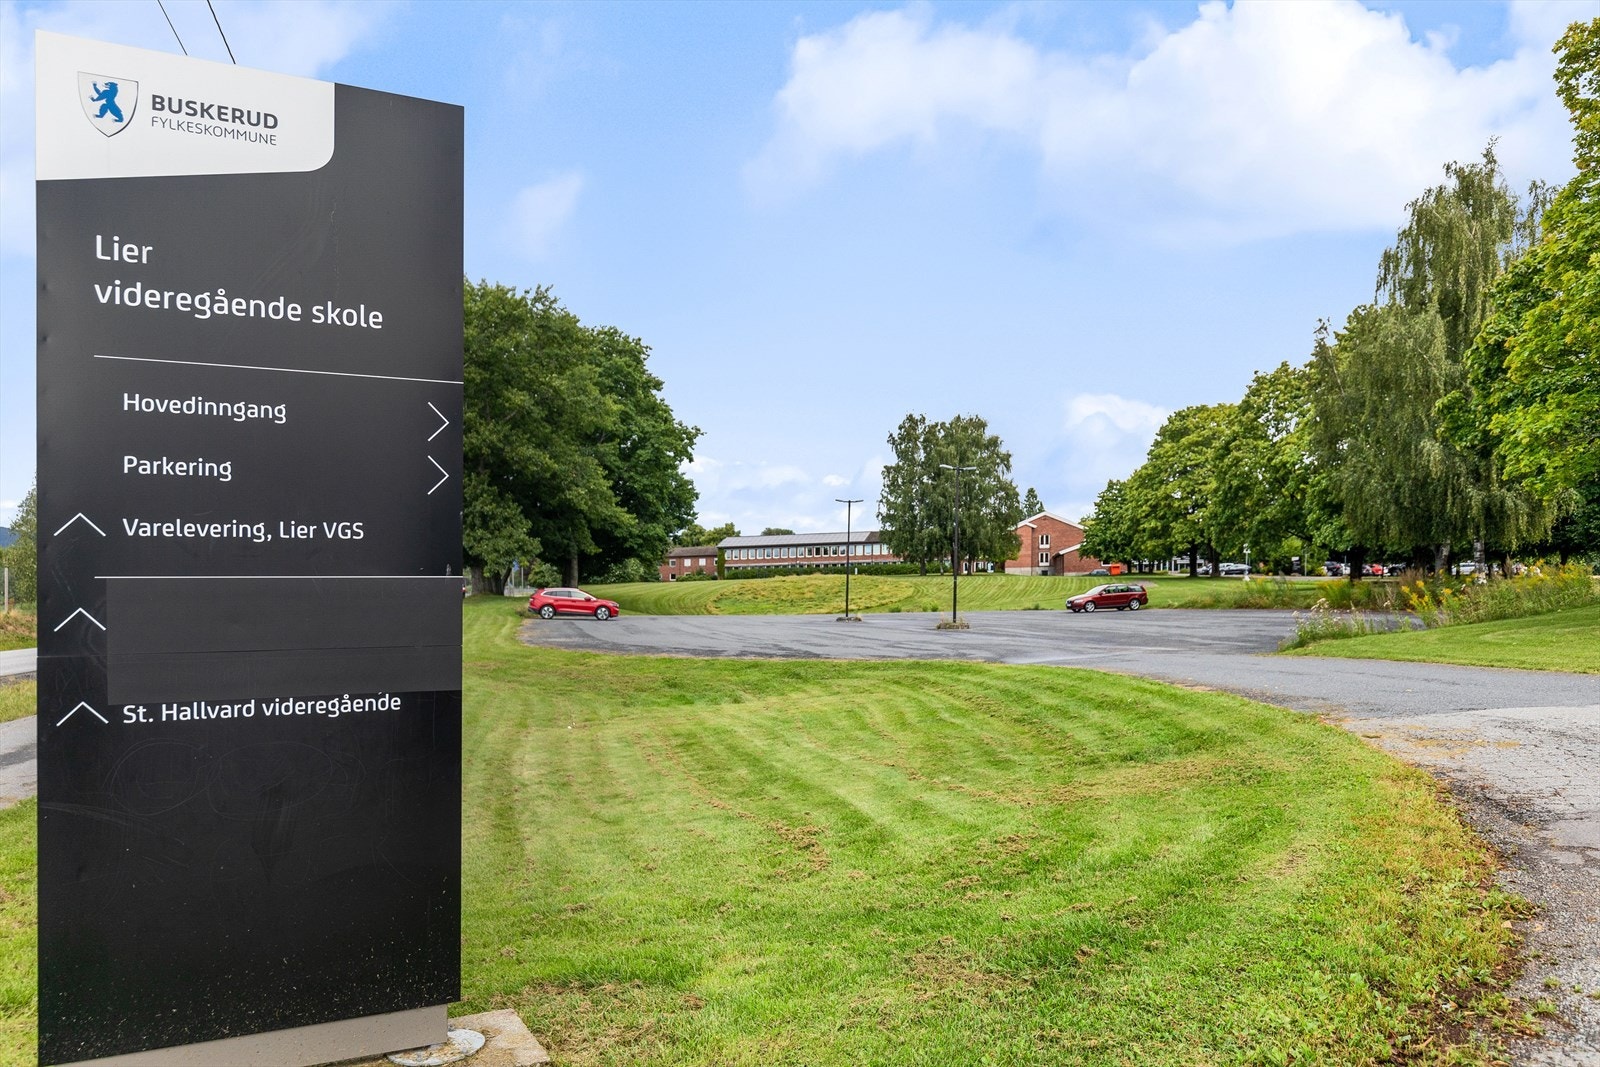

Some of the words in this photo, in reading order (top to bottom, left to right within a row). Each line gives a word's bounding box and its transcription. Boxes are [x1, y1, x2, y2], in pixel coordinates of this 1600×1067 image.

[151, 94, 278, 130] BUSKERUD
[151, 116, 277, 146] FYLKESKOMMUNE
[95, 234, 153, 264] Lier
[94, 280, 301, 321] videregående
[312, 301, 383, 329] skole
[123, 393, 287, 424] Hovedinngang
[123, 456, 232, 481] Parkering
[123, 518, 272, 542] Varelevering,
[279, 521, 317, 539] Lier
[323, 522, 364, 540] VGS
[123, 705, 154, 724] St.
[162, 699, 255, 722] Hallvard
[261, 693, 402, 719] videregående
